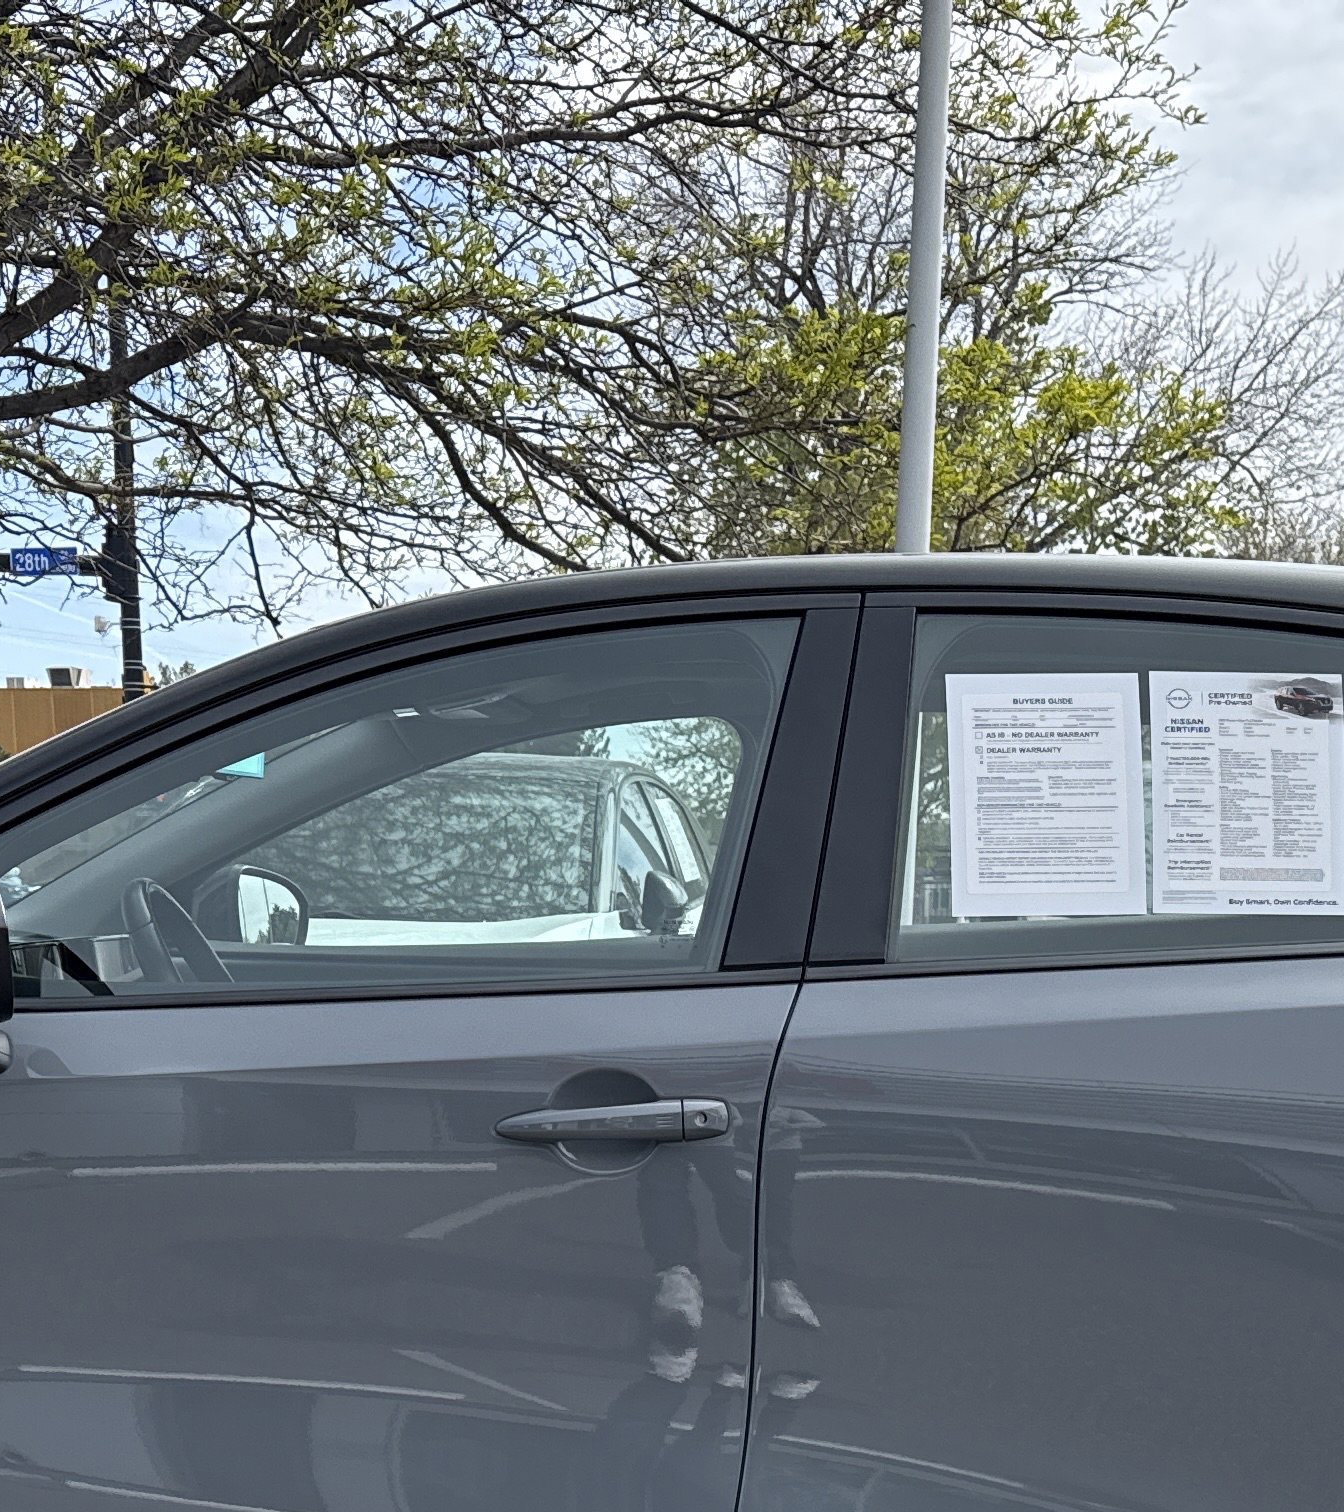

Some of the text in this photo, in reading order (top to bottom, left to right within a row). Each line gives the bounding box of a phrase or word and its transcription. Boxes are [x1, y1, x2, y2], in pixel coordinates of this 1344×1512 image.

[15, 553, 49, 572] 28th
[1012, 697, 1073, 705] BUYERS GUIDE
[1018, 746, 1062, 754] WARRANTY
[1228, 898, 1244, 906] Buy
[1245, 898, 1272, 906] Smart,
